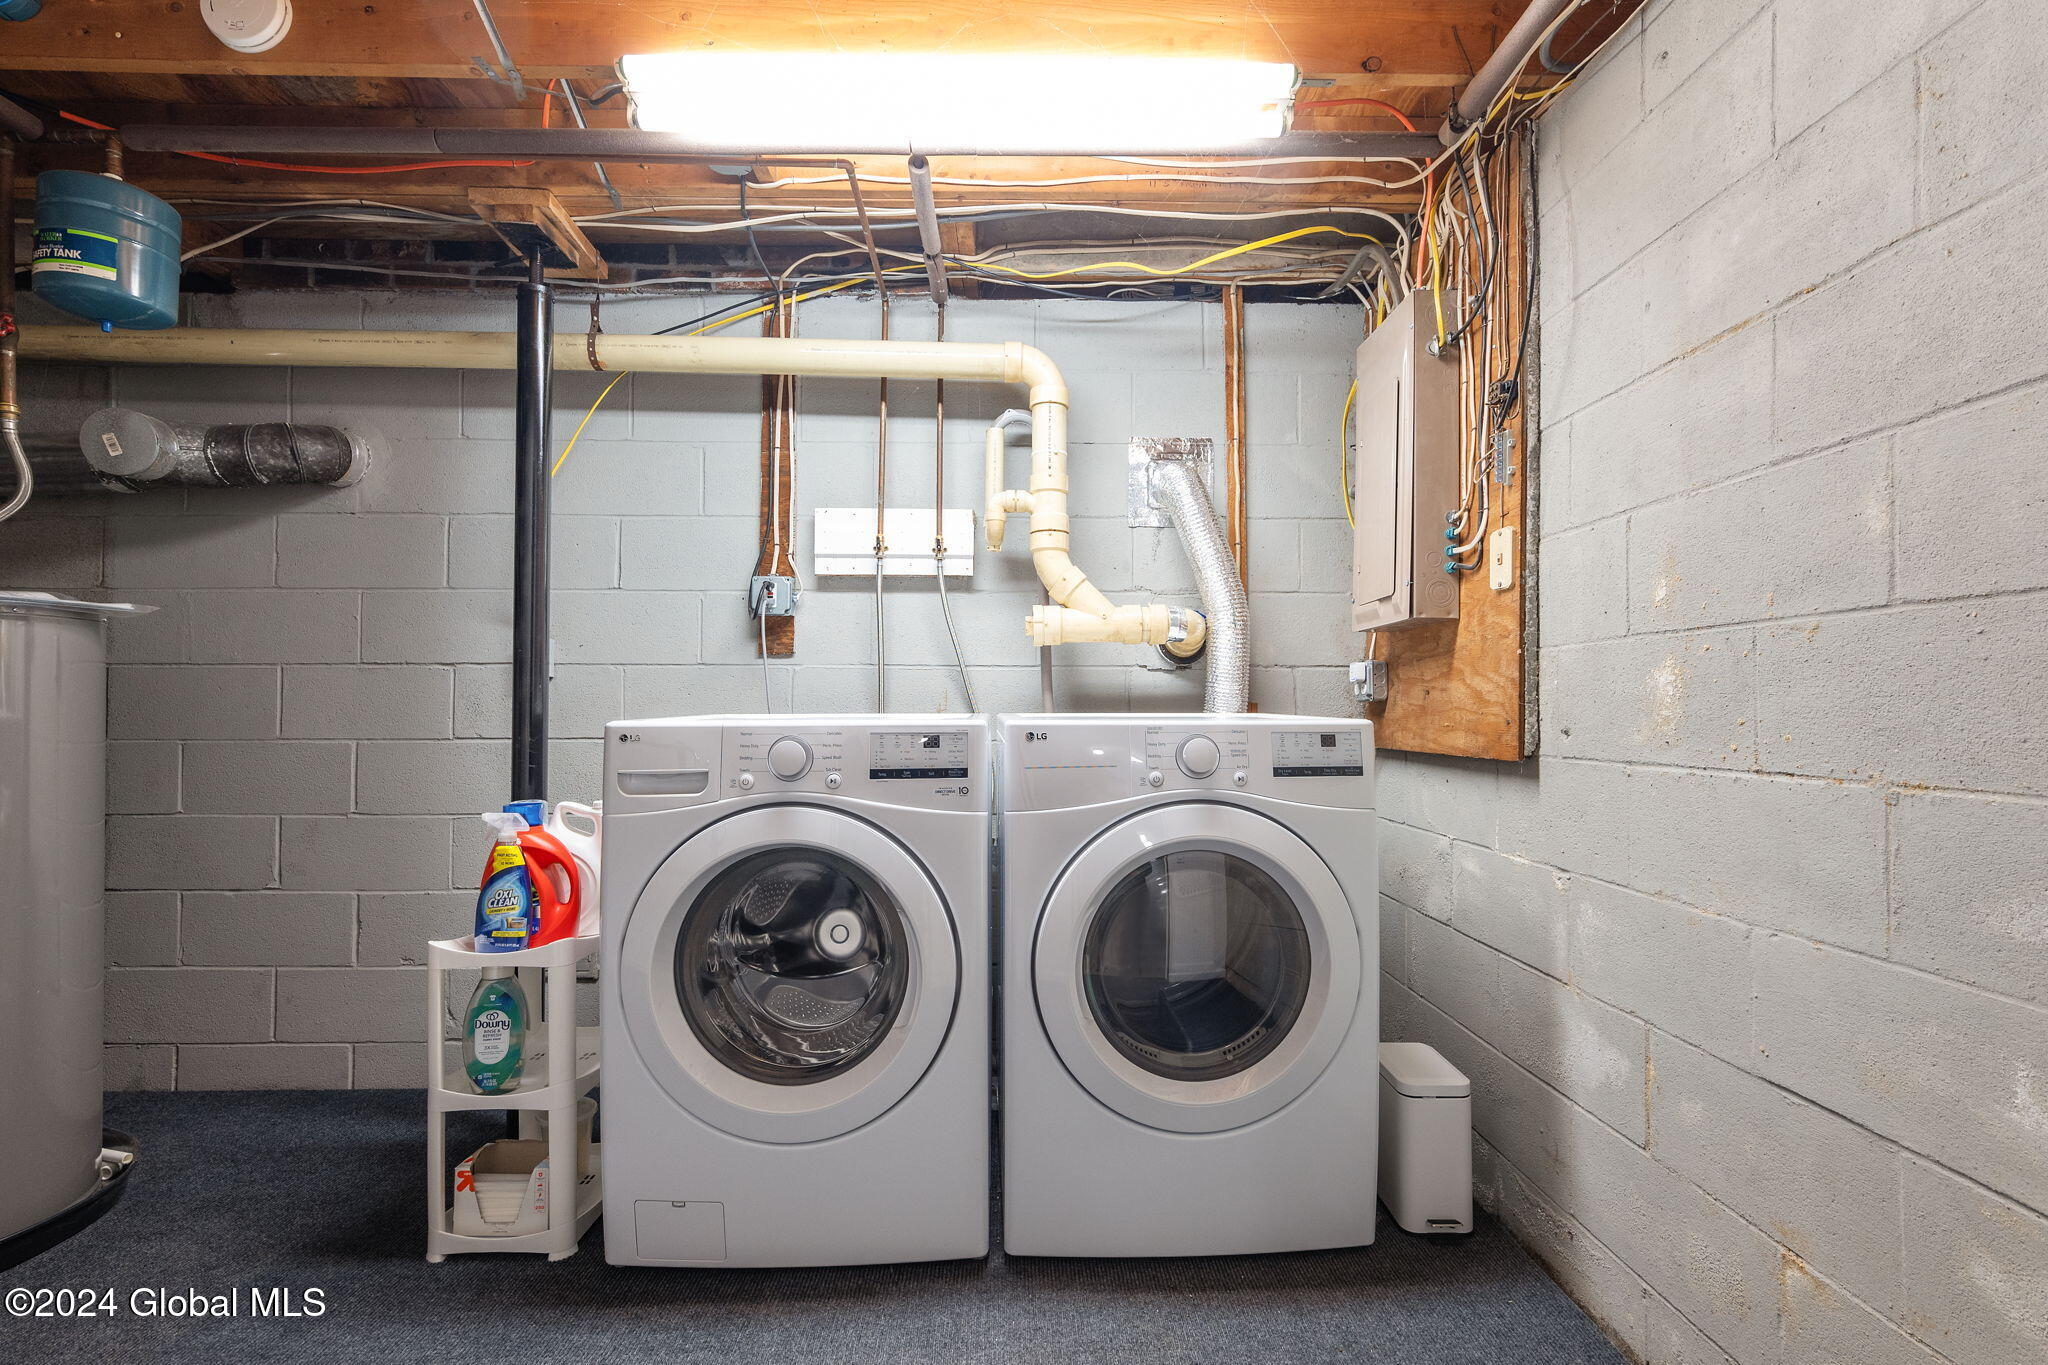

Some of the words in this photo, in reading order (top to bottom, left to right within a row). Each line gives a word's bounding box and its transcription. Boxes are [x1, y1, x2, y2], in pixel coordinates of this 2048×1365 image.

[53, 248, 81, 259] TANK
[495, 889, 512, 899] OXI
[488, 897, 518, 908] CLEAN
[474, 1019, 511, 1031] Downy
